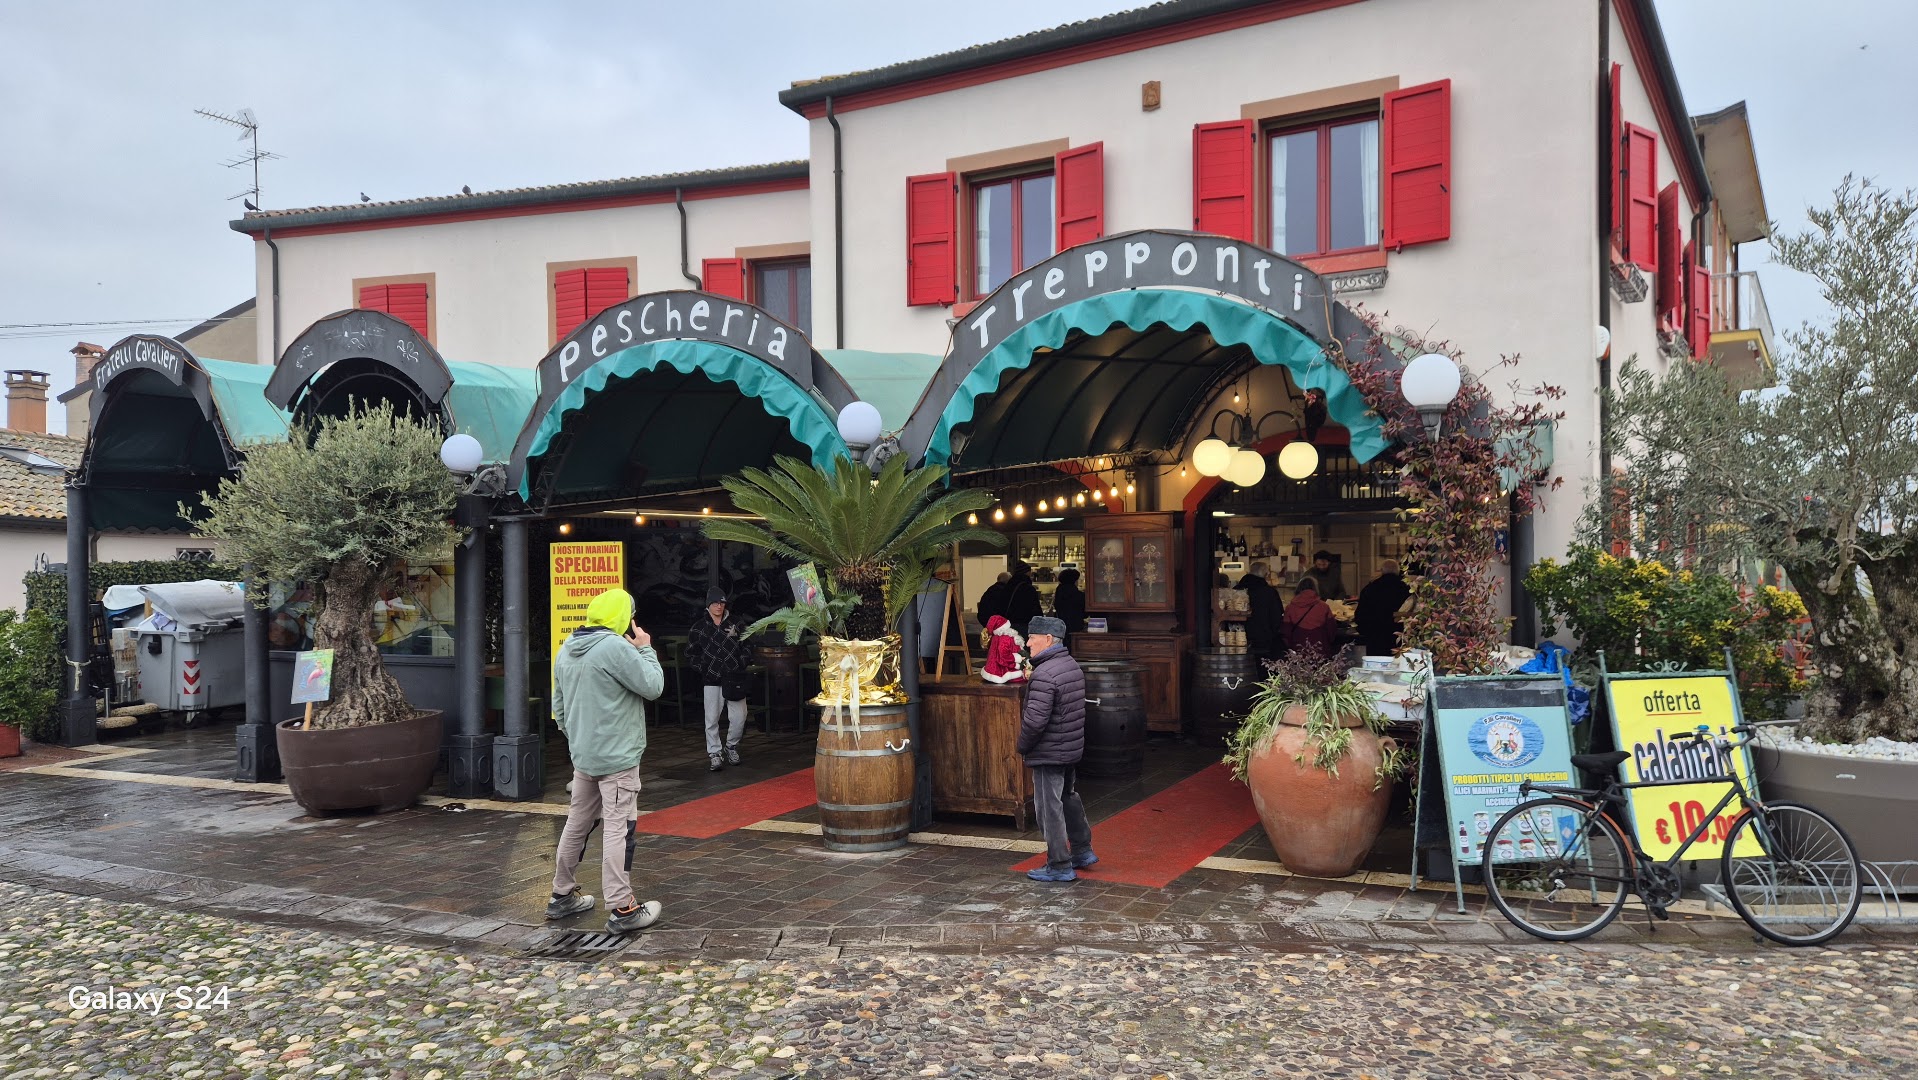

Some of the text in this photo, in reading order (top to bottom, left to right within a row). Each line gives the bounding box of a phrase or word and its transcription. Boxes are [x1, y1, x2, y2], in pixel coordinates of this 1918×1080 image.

[970, 241, 1304, 349] Trepponti
[135, 339, 179, 375] Cavalieri
[553, 544, 620, 555] I NOSTRI MARINATI
[555, 556, 618, 573] SPECIALI
[554, 575, 620, 586] DELLA PESCHERIA
[1643, 690, 1701, 713] offerta
[1452, 771, 1569, 784] PRODOTTI TIPICI DI COMACCHIO
[1453, 786, 1471, 795] ALICI
[1471, 786, 1504, 795] MARINATE
[1485, 797, 1518, 807] ACCIUGHE
